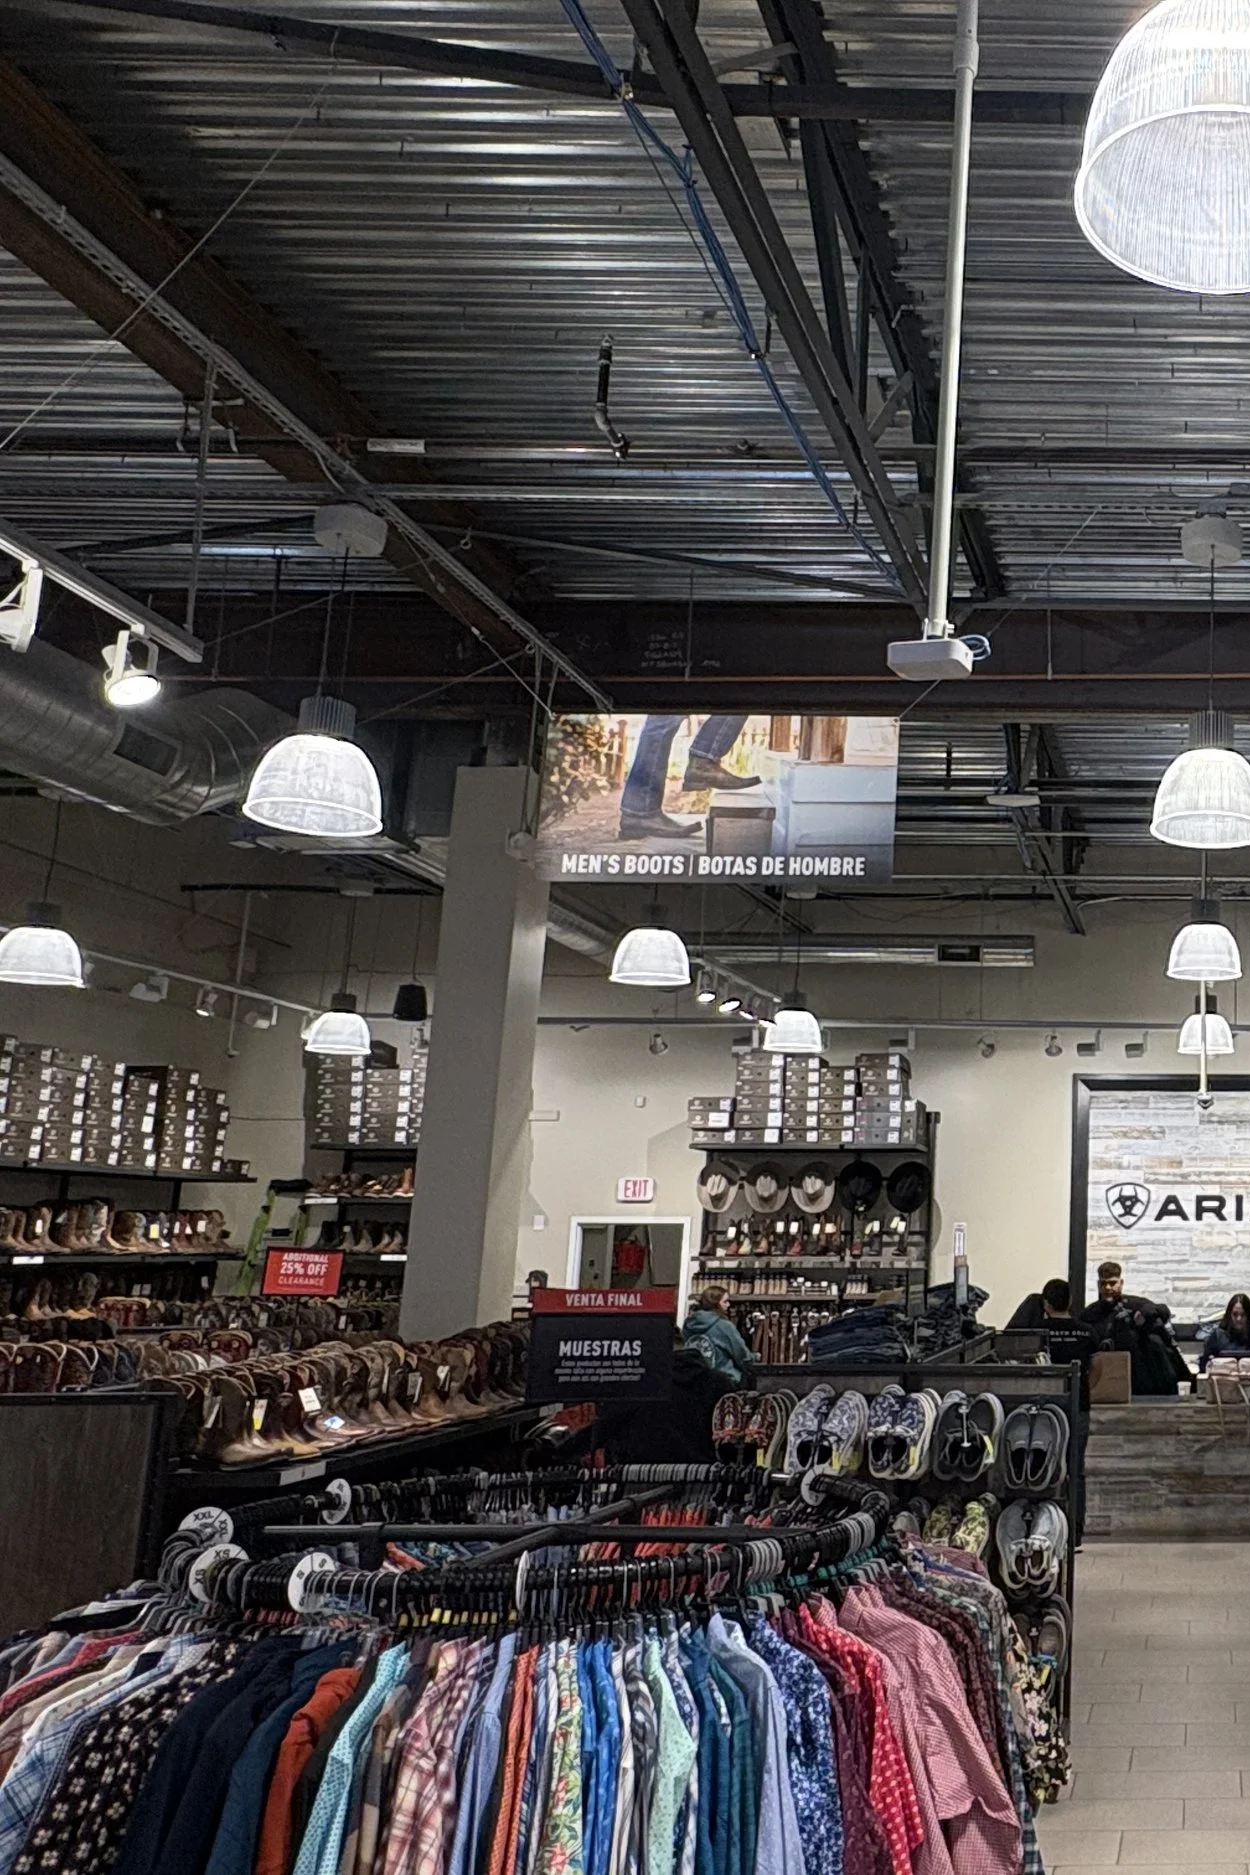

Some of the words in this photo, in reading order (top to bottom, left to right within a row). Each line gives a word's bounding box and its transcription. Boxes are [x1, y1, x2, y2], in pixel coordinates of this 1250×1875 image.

[562, 854, 620, 875] MEN'S
[624, 855, 686, 876] BOOTS
[699, 855, 758, 876] BOTAS
[761, 856, 785, 876] DE
[789, 856, 866, 877] HOMBRE
[624, 1179, 649, 1198] EXIT
[283, 1253, 328, 1263] ADDITIONAL
[280, 1262, 305, 1275] 25%
[306, 1263, 329, 1276] OFF
[278, 1277, 324, 1286] CLEARANCE
[565, 1293, 605, 1307] VENTA
[607, 1293, 643, 1307] FINAL
[558, 1340, 642, 1357] MUESTRAS
[193, 1511, 214, 1522] XXL
[214, 1549, 231, 1560] XS
